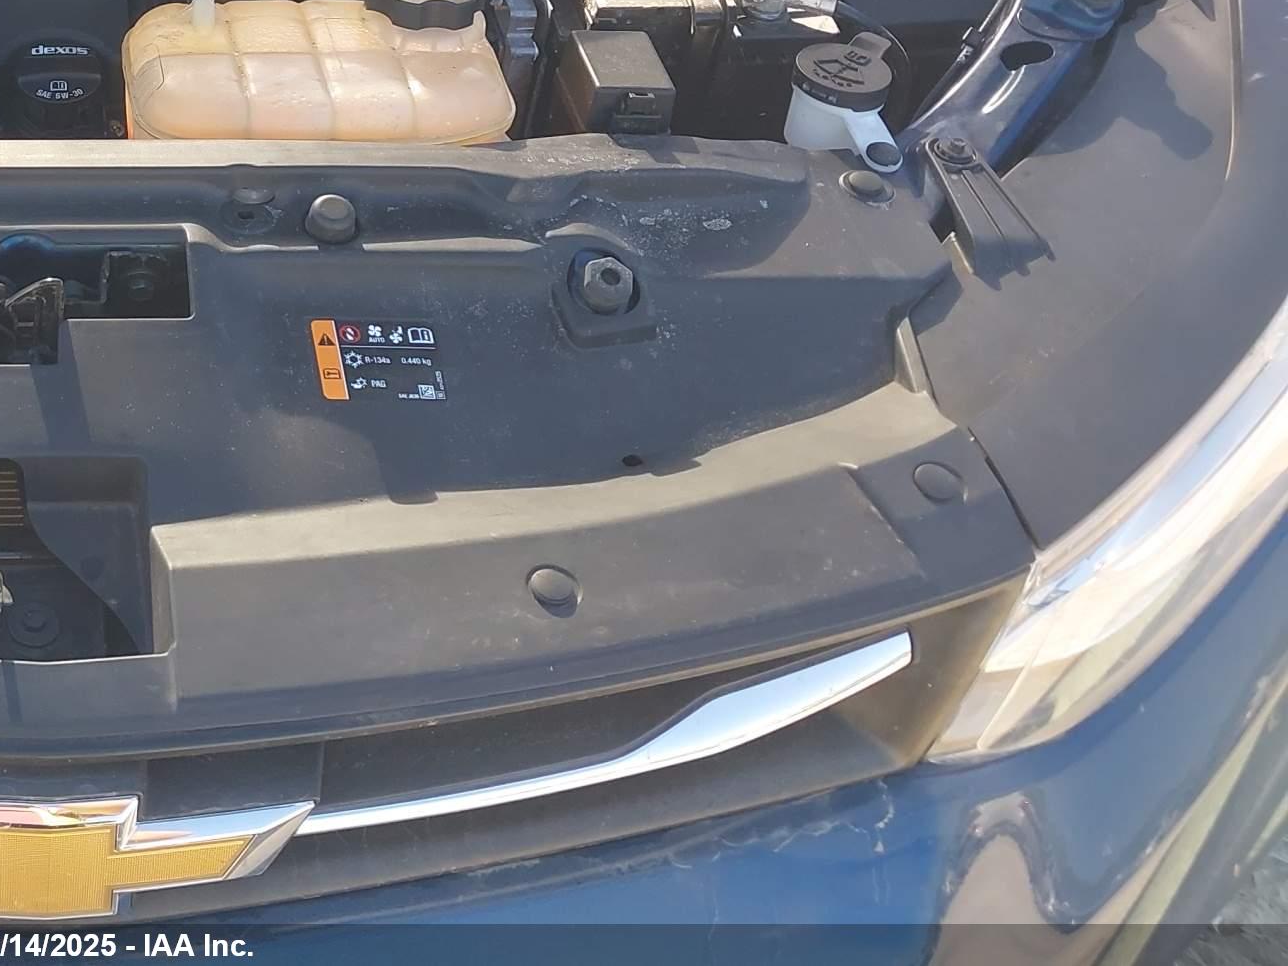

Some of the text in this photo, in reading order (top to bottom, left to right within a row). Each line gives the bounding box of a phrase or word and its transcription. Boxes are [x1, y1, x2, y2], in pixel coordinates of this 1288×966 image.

[31, 45, 89, 55] dexos
[36, 89, 52, 99] SAE
[364, 356, 391, 364] R-134a
[422, 357, 432, 366] kg
[371, 380, 387, 388] PAG
